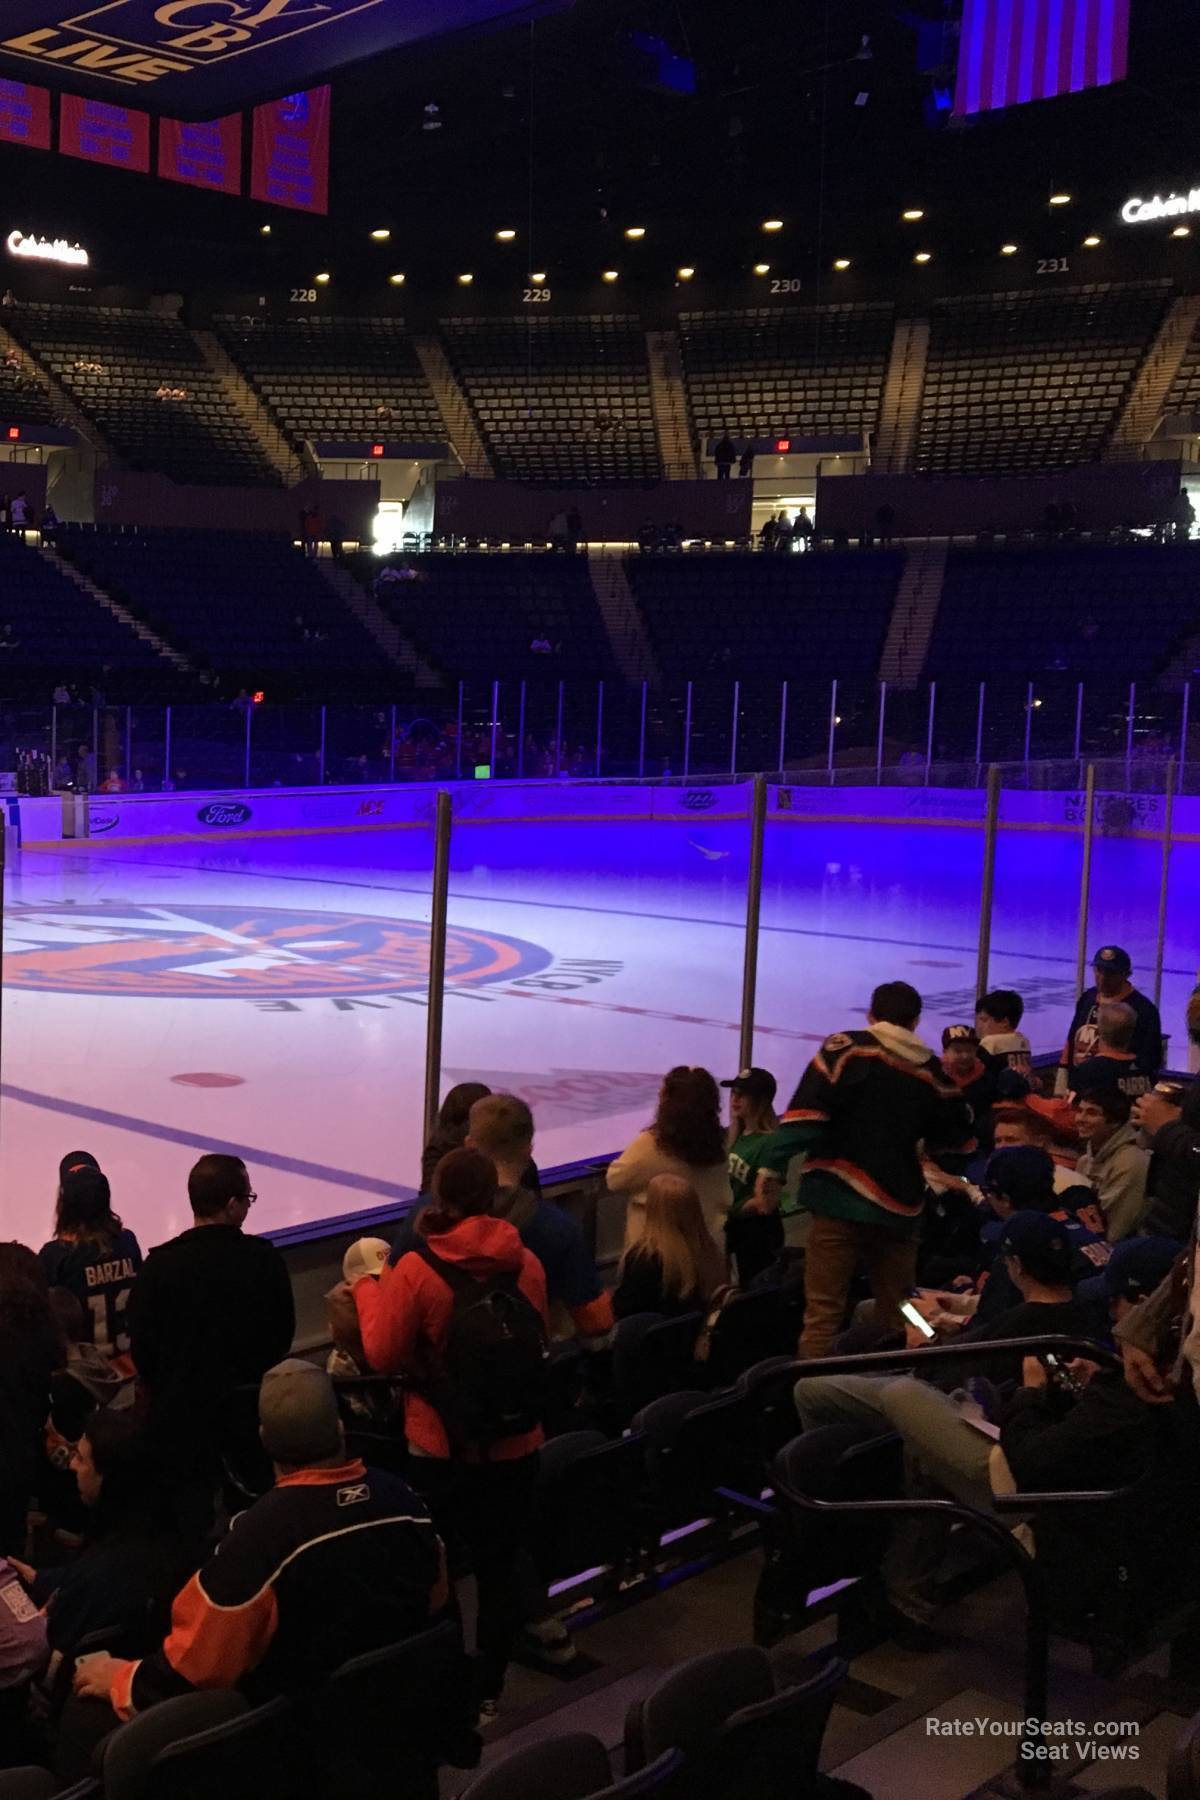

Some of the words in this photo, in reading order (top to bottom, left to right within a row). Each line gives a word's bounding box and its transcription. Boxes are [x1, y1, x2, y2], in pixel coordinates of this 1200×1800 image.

[0, 28, 195, 82] LIVE
[1121, 195, 1188, 223] Calvin
[1036, 257, 1070, 274] 231
[290, 289, 317, 302] 228
[522, 289, 551, 302] 229
[770, 279, 801, 293] 230
[205, 803, 245, 824] Ford
[511, 957, 624, 990] NYCB
[84, 1257, 138, 1287] BARZAL
